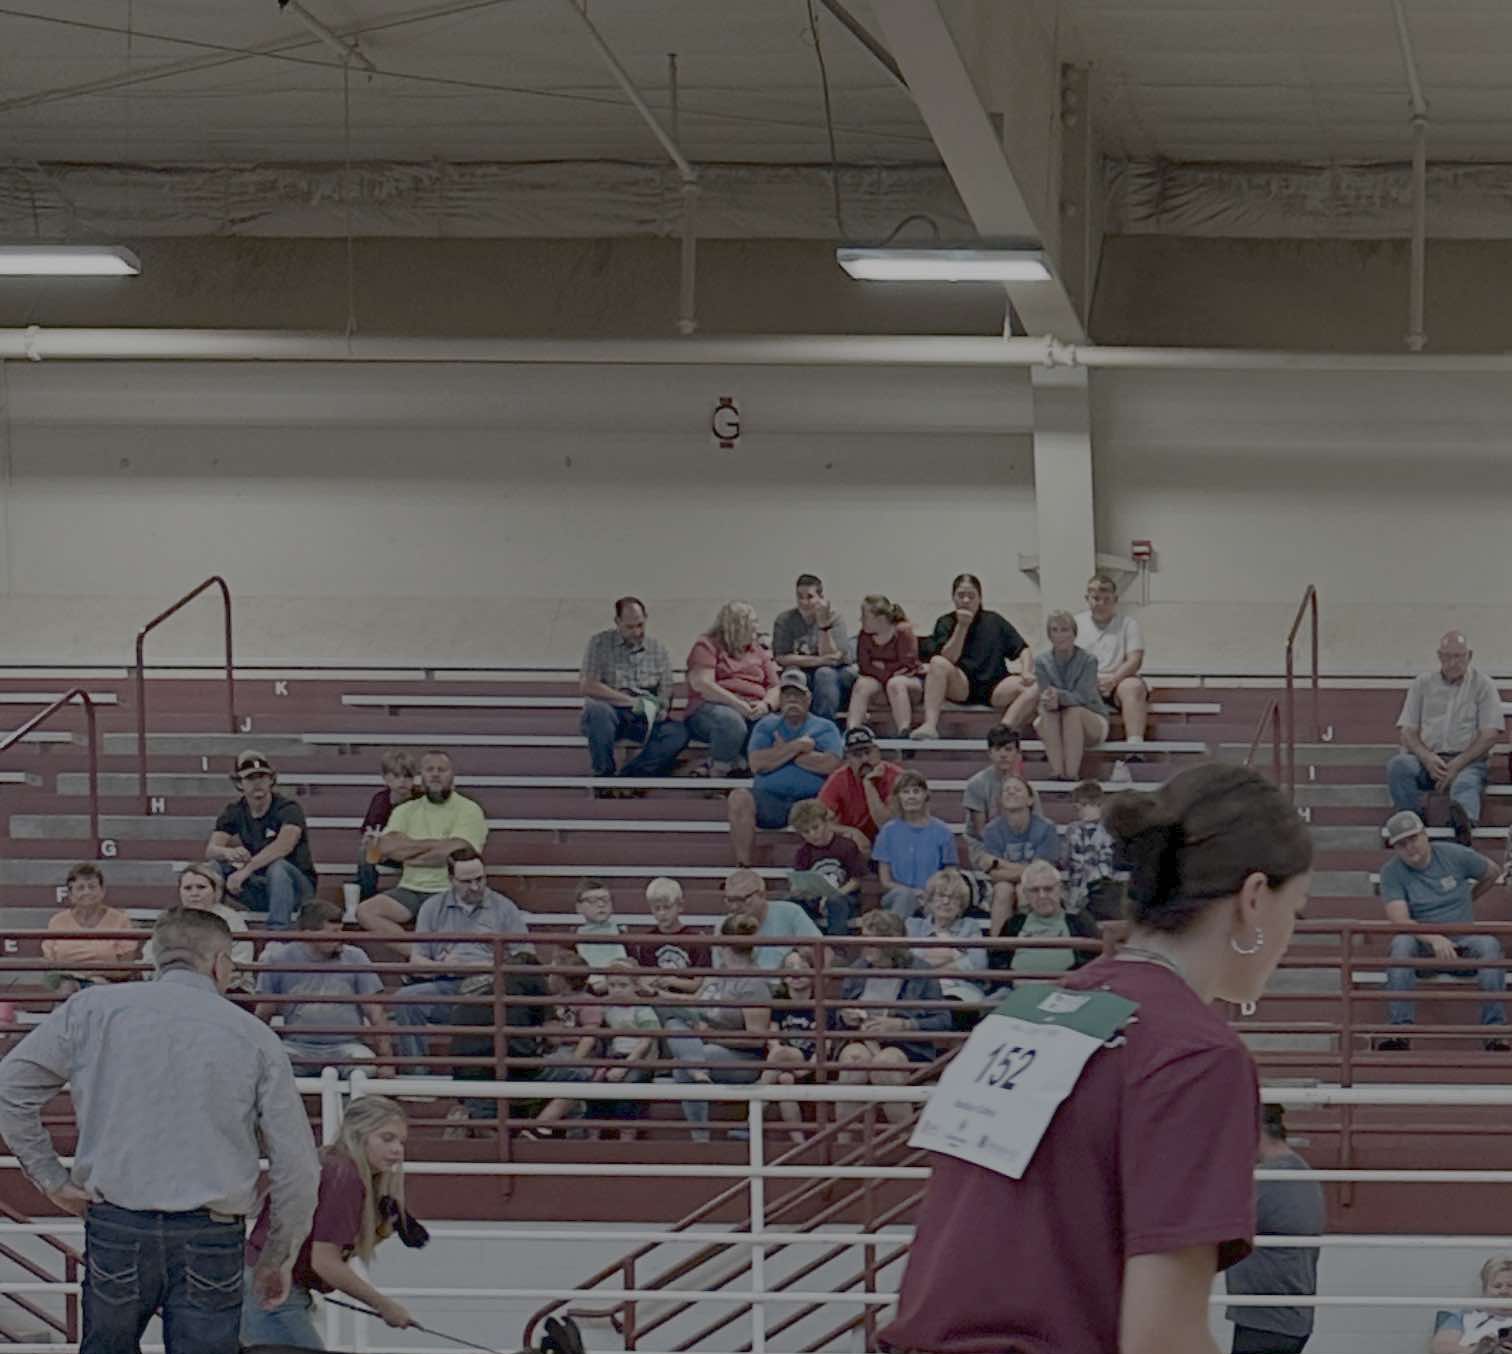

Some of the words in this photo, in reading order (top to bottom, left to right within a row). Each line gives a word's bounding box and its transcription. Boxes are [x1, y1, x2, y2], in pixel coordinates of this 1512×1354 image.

[712, 405, 740, 440] G
[275, 681, 288, 696] K
[240, 717, 251, 732] J
[1321, 725, 1333, 741] J
[202, 756, 208, 771] I
[1309, 765, 1315, 780] I
[152, 797, 165, 813] H
[101, 839, 117, 856] G
[56, 886, 69, 903] F
[974, 1041, 1037, 1090] 152
